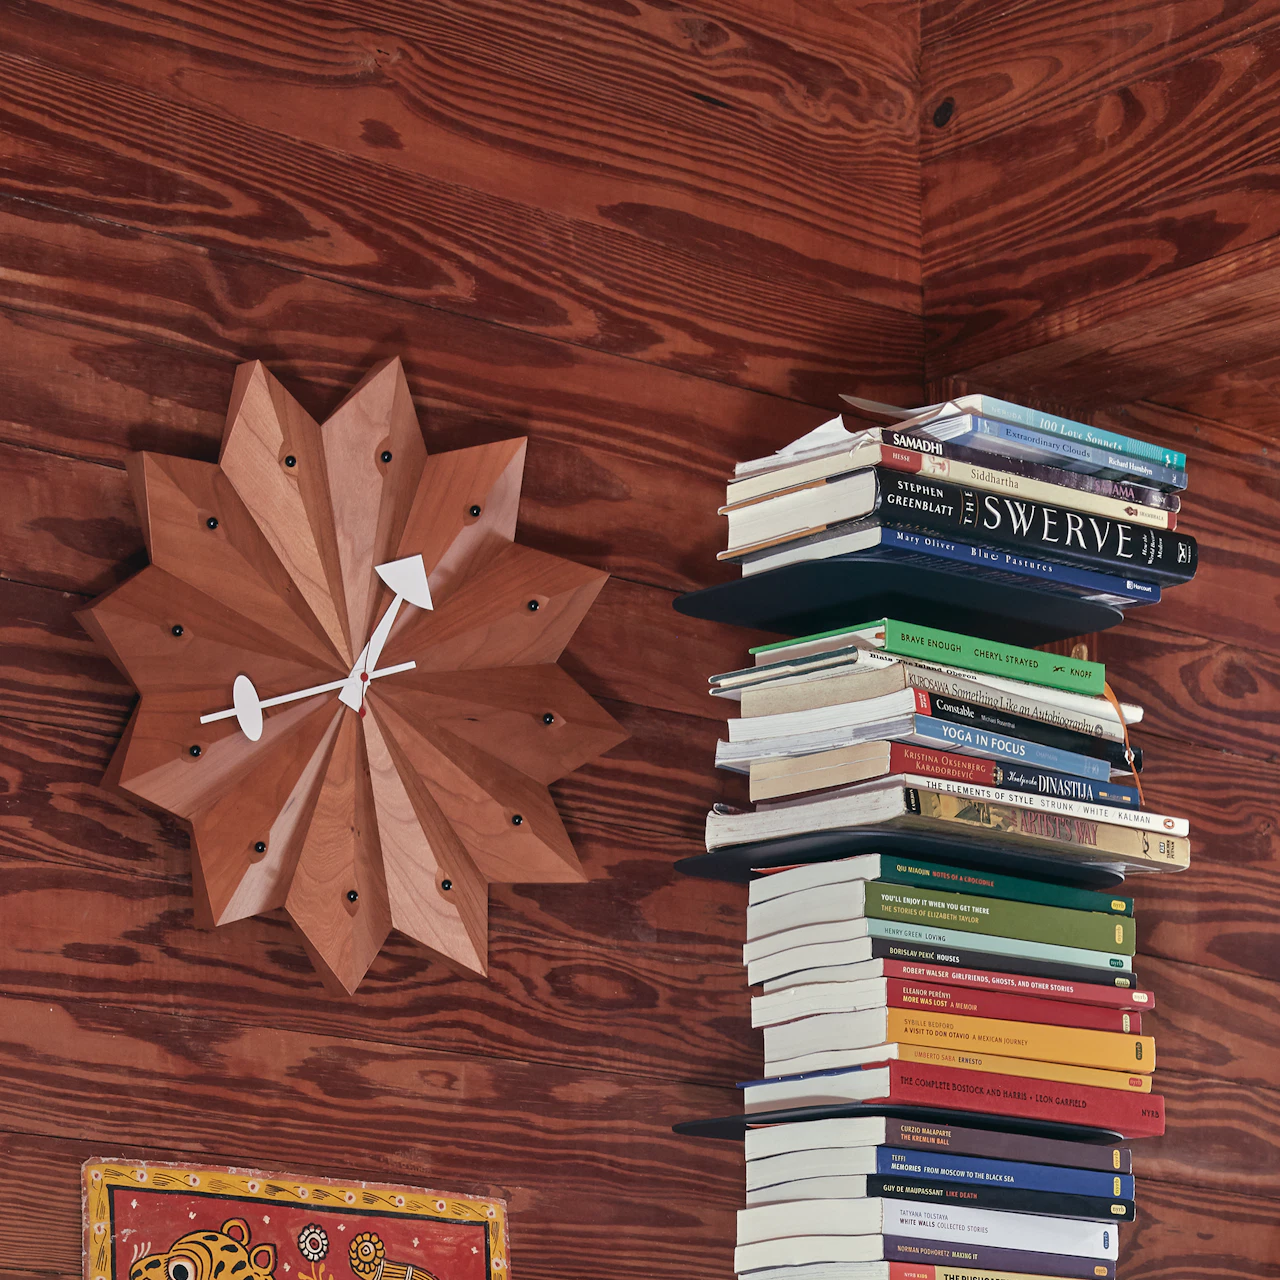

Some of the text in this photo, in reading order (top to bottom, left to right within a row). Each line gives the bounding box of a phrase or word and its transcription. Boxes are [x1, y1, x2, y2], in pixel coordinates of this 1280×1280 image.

[893, 433, 943, 455] SAMADHI
[1006, 428, 1091, 458] Extraordinary Clouds
[1039, 418, 1123, 452] 100 Love Sonnets
[1108, 456, 1128, 470] Richard
[1129, 461, 1153, 476] Hamblyn
[897, 480, 944, 498] STEPHEN
[971, 469, 1019, 489] Siddhartha
[887, 494, 954, 517] GREENBLATT
[983, 495, 1134, 559] SWERVE
[896, 532, 955, 551] Mary Oliver
[971, 547, 1054, 573] Blue Pastures
[901, 633, 962, 653] BRAVE ENOUGH
[974, 649, 1039, 669] CHERYL STRAYED
[1070, 668, 1092, 679] KNOPF
[909, 674, 950, 695] KUROSAWA
[952, 684, 999, 711] Something
[1000, 695, 1018, 712] Like
[1019, 703, 1031, 716] an
[1032, 706, 1094, 736] Autobiography
[936, 699, 975, 719] Constable
[942, 725, 1026, 756] YOGA IN FOCUS
[904, 749, 986, 773] KRISTINA OKSENBERG
[926, 781, 1034, 805] THE ELEMENTS OF STYLE
[1038, 774, 1094, 801] DINASTIJA
[1040, 799, 1151, 824] STRUNK WHITE KALMAN
[890, 947, 960, 963] BORISLAV PEKIĆ HOUSES
